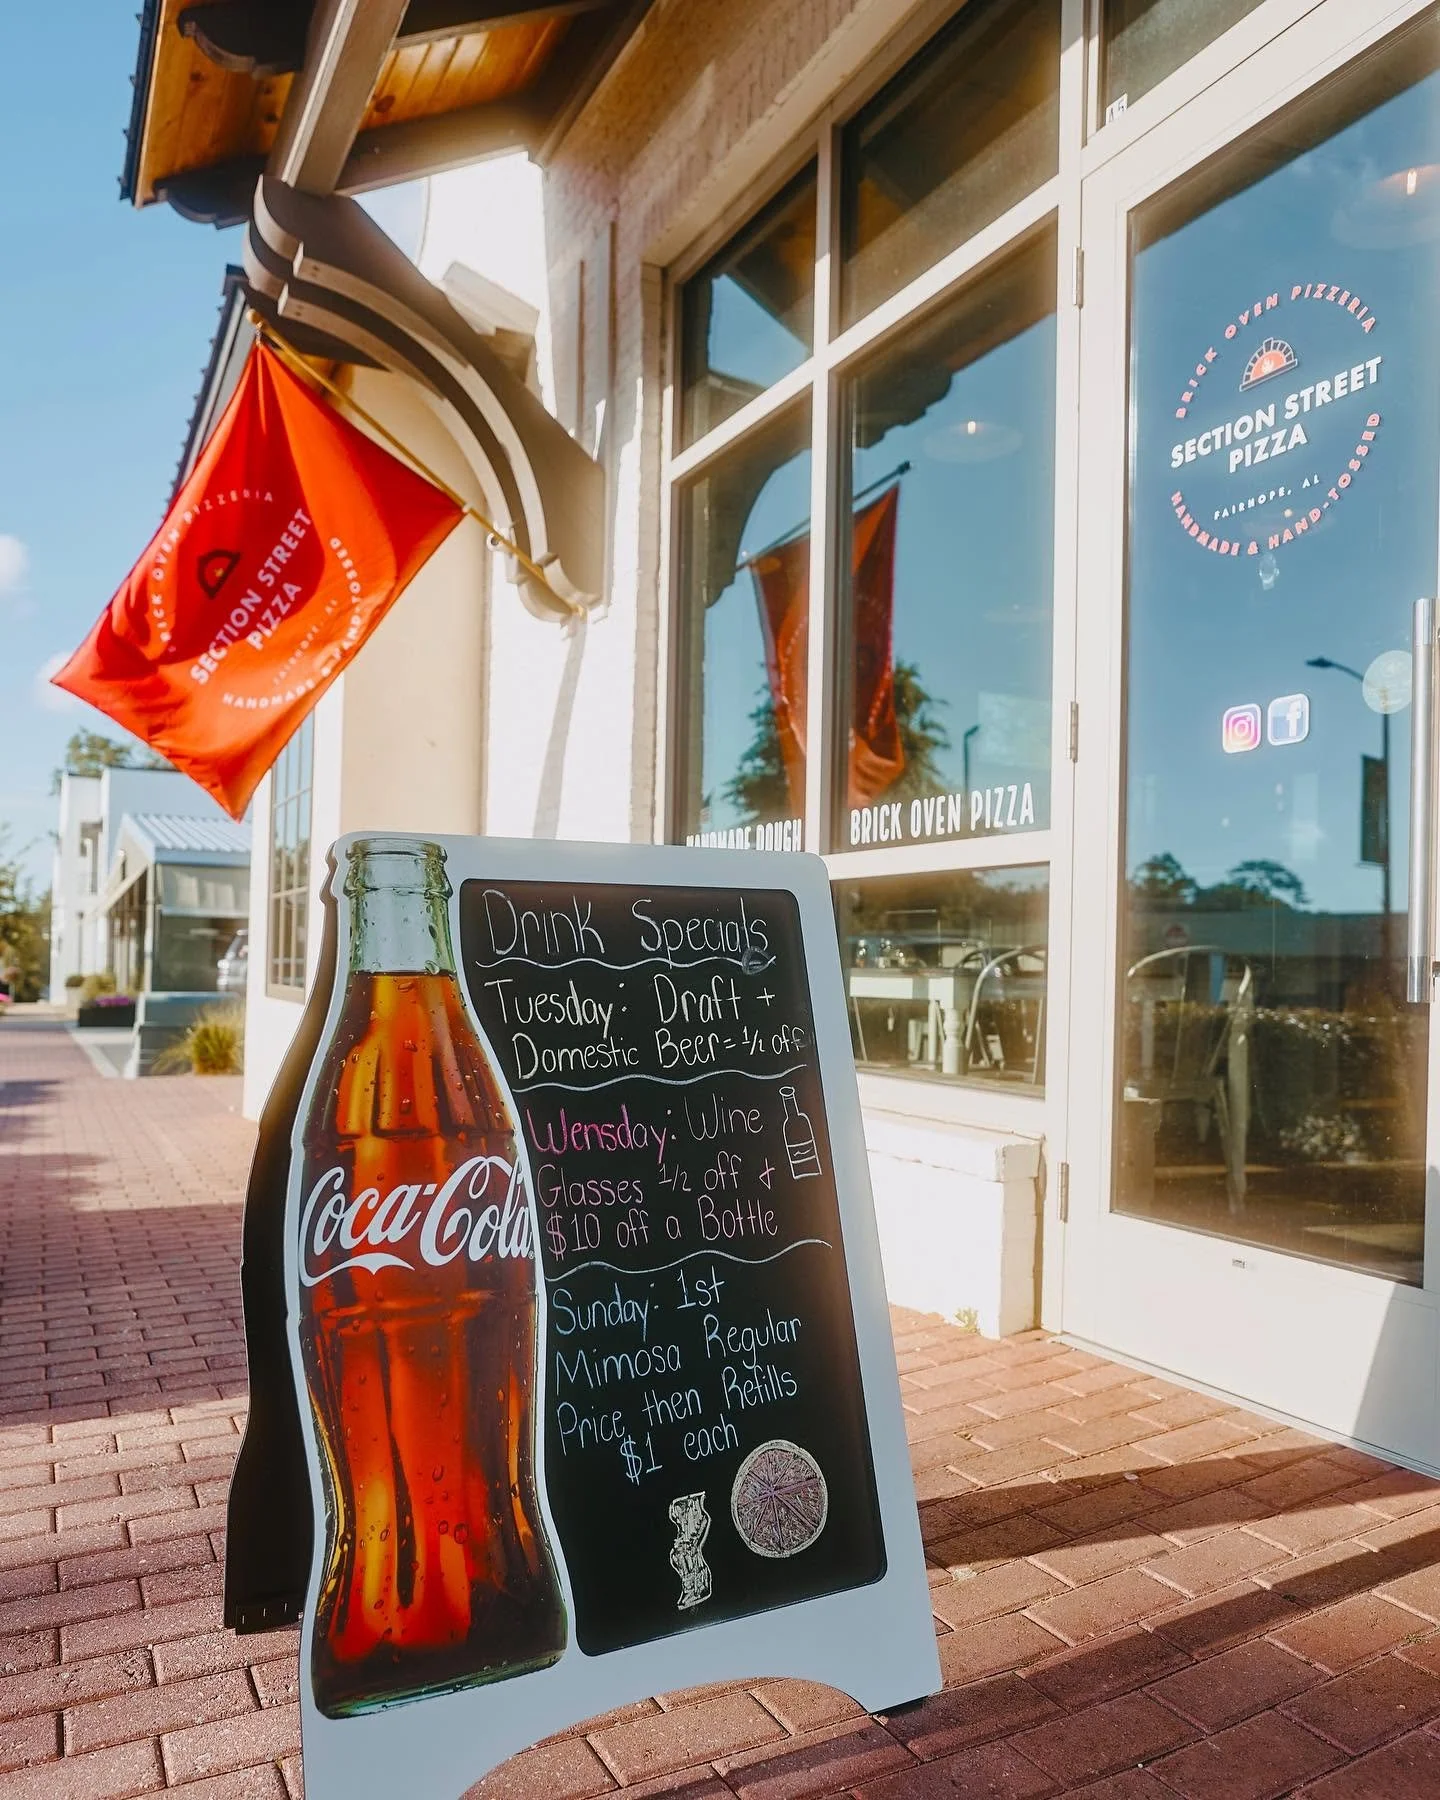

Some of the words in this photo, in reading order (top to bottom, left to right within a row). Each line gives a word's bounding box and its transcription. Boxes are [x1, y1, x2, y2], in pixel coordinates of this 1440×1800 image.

[1175, 346, 1217, 418] BRICK
[1224, 293, 1278, 339] OVEN
[1291, 283, 1376, 333] PIZZERIA
[1171, 403, 1276, 468] SECTION
[1284, 356, 1382, 420] STREET
[1229, 423, 1308, 473] PIZZA
[1171, 490, 1240, 556] HANDMADE
[1247, 541, 1259, 555] &
[1268, 413, 1381, 550] HAND-TOSSED
[1214, 486, 1292, 520] FAIRHOPE,
[1302, 474, 1320, 488] AL
[190, 588, 263, 685] SECTION
[257, 508, 312, 587] STREET
[246, 581, 302, 650] PIZZA
[756, 818, 803, 852] DOUGH
[850, 801, 902, 846] BRICK
[910, 793, 961, 839] OVEN
[970, 782, 1035, 831] PIZZA
[482, 889, 605, 955] Drink
[631, 897, 769, 968] Specials
[484, 978, 628, 1040] Tuesday:
[653, 974, 742, 1024] Draft
[756, 987, 776, 1007] +
[511, 1034, 640, 1079] Domestic
[771, 1024, 806, 1054] off
[526, 1103, 677, 1164] Wensday:
[684, 1092, 764, 1141] Wine
[537, 1163, 644, 1209] Glasses
[703, 1150, 742, 1191] off
[300, 1156, 535, 1287] Coca-Cola
[546, 1211, 602, 1261] $10
[616, 1209, 649, 1249] off
[665, 1216, 682, 1239] a
[698, 1194, 778, 1241] Bottle
[552, 1282, 660, 1342] Sunday:
[676, 1265, 725, 1309] 1st
[555, 1343, 682, 1396] Mimosa
[703, 1308, 802, 1370] Regular
[556, 1400, 626, 1456] Price
[641, 1387, 703, 1428] then
[720, 1363, 798, 1411] Refills
[619, 1431, 663, 1486] $1
[683, 1413, 739, 1461] each
